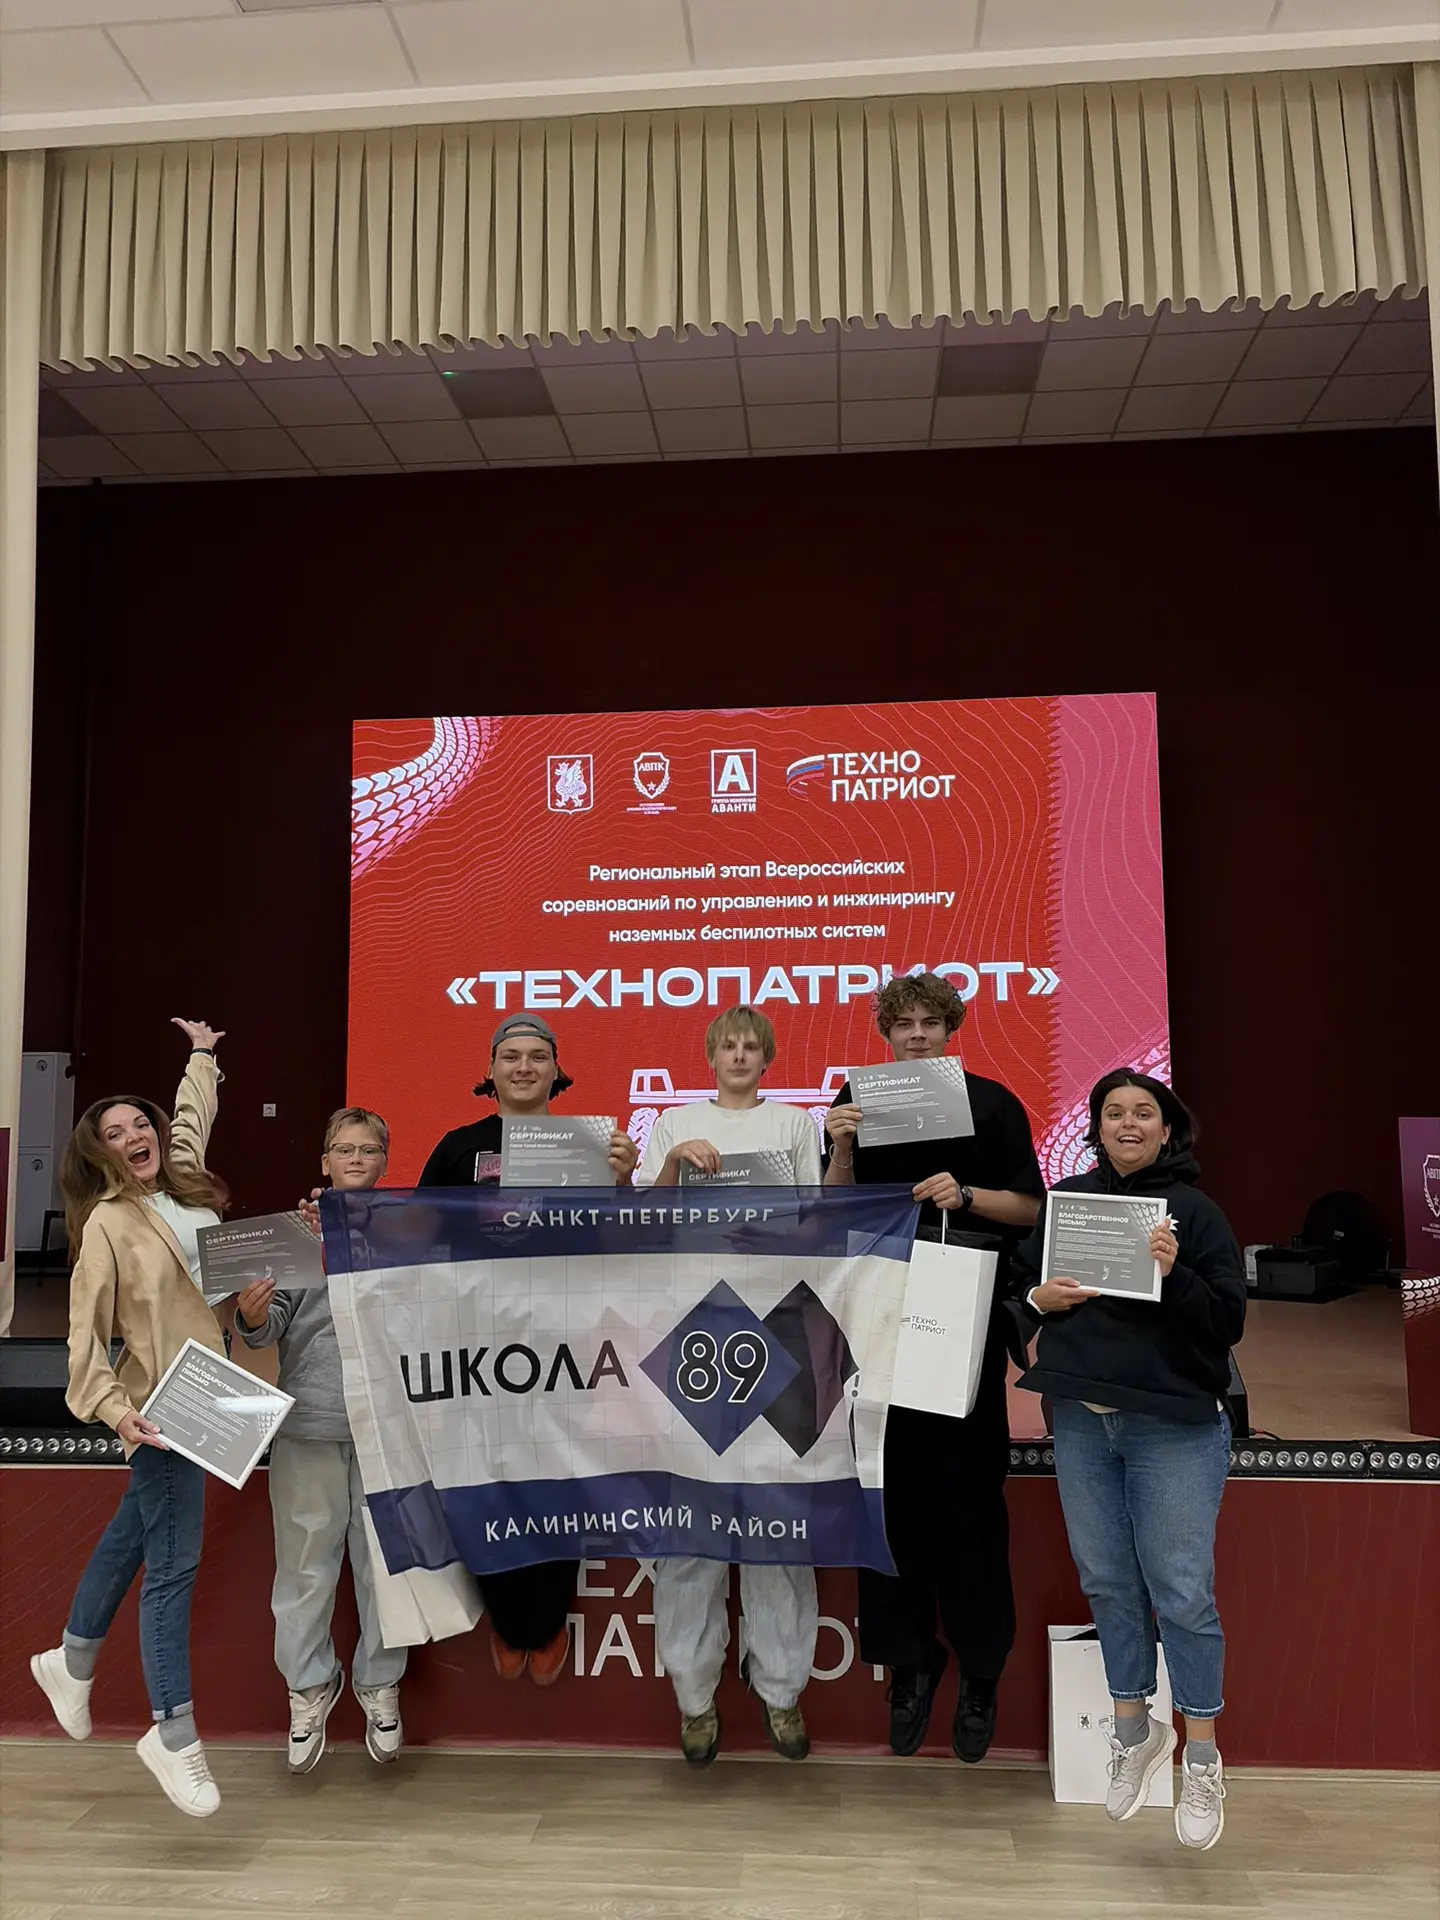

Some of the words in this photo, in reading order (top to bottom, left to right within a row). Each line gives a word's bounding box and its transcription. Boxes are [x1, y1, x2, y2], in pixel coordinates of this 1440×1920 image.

[638, 761, 665, 772] АВПК
[827, 750, 921, 776] ТЕХНО
[831, 774, 956, 802] ПАТРИОТ
[711, 803, 756, 812] АВАНТИ
[589, 863, 716, 881] Региональный
[719, 865, 760, 879] этап
[765, 859, 905, 880] Всероссийских
[542, 895, 670, 916] соревнований
[674, 897, 697, 910] по
[700, 894, 813, 913] управлению
[817, 894, 829, 907] и
[833, 891, 956, 909] инжинирингу
[609, 928, 696, 943] наземных
[700, 924, 818, 941] беспилотных
[822, 924, 886, 938] систем
[857, 1076, 921, 1090] СЕРТИФИКАТ
[509, 1132, 575, 1140] СЕРТИФИКАТ
[502, 1208, 774, 1228] САНКТ-ПЕТЕРБУРГ
[1057, 1219, 1087, 1227] ПИСЬМО
[1058, 1212, 1129, 1224] БЛАГОДАРСТВЕННОЕ
[205, 1228, 274, 1245] СЕРТИФИКАТ
[911, 1315, 938, 1326] ТЕХНО
[911, 1323, 946, 1335] ПАТРИОТ
[400, 1339, 630, 1404] ШКОЛА
[675, 1330, 769, 1403] 89
[180, 1366, 210, 1387] ПИСЬМО
[485, 1504, 693, 1543] КАЛИНИНСКИЙ
[710, 1514, 808, 1540] РАЙОН
